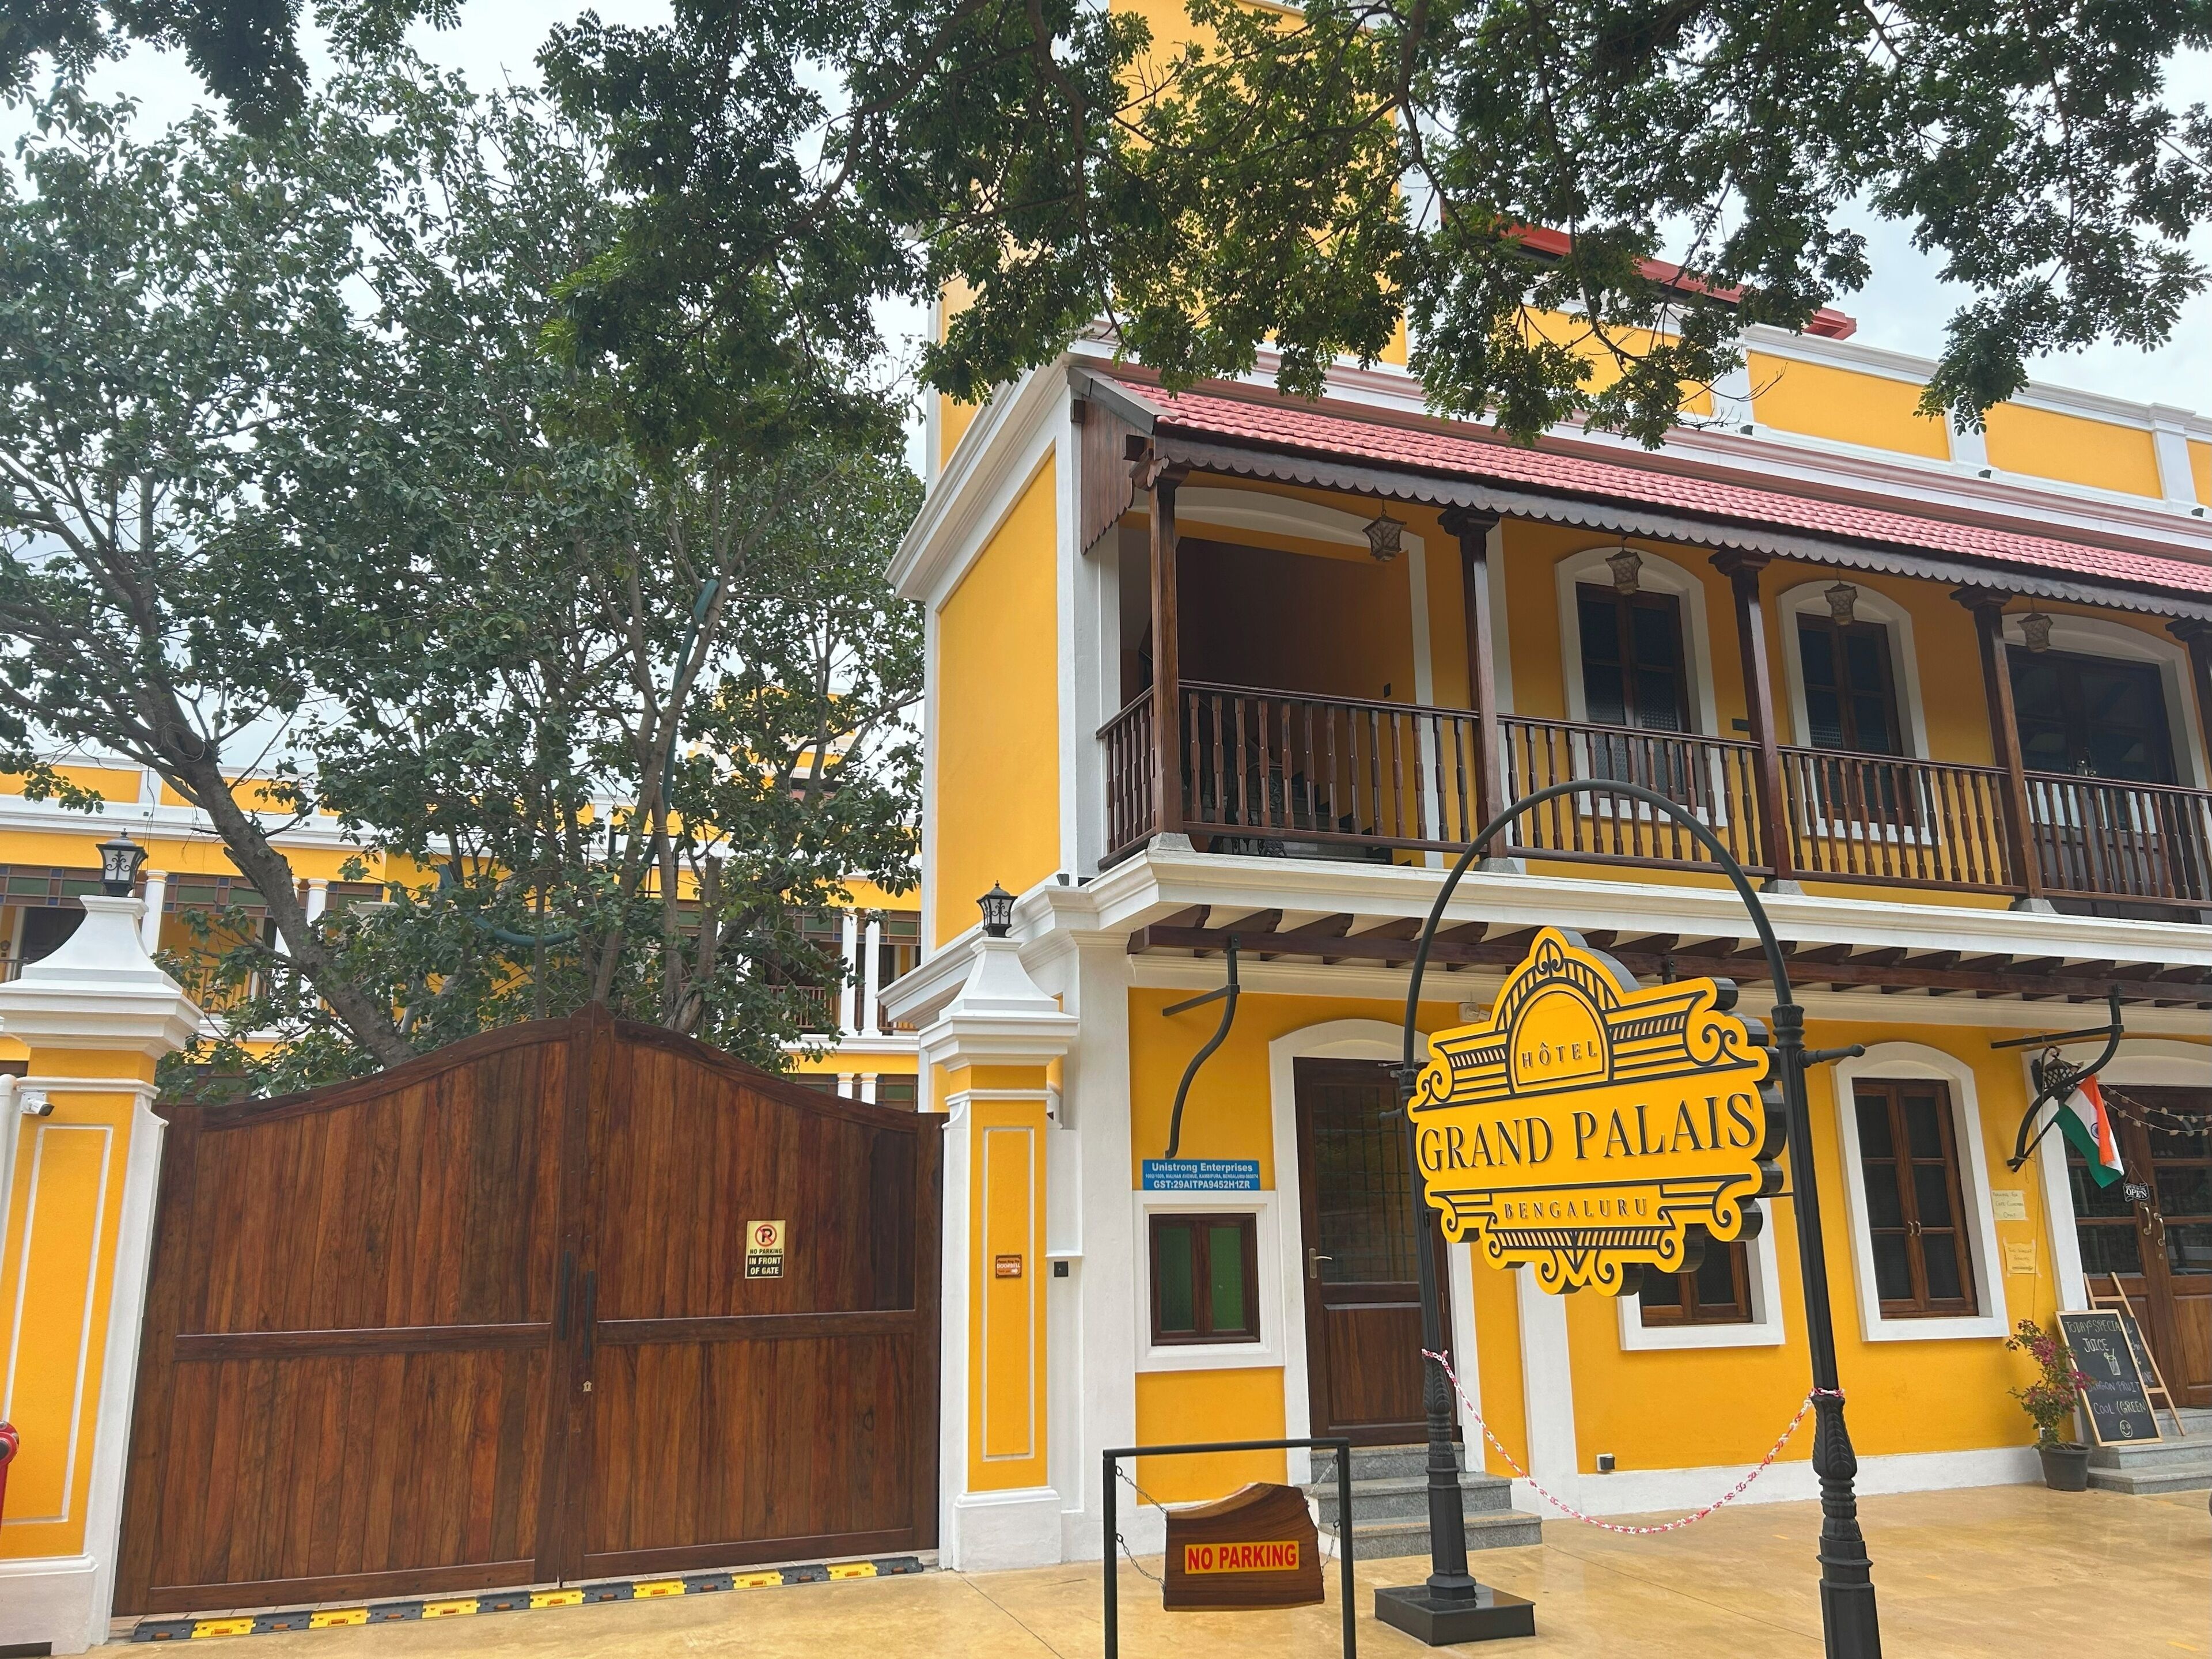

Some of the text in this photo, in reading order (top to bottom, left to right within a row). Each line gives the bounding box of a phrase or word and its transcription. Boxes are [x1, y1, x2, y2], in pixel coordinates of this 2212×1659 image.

[1522, 1040, 1597, 1068] HÔTEL
[1421, 1092, 1757, 1172] GRAND PALAIS
[1152, 1162, 1253, 1172] Unistrong Enterprises
[2126, 1188, 2147, 1198] OPEN
[1504, 1198, 1647, 1219] BENGALURU
[2082, 1338, 2109, 1353] JUICE
[2116, 1381, 2140, 1392] FRUIT
[2116, 1398, 2149, 1416] (GREEN)
[1188, 1544, 1296, 1570] NO PARKING
